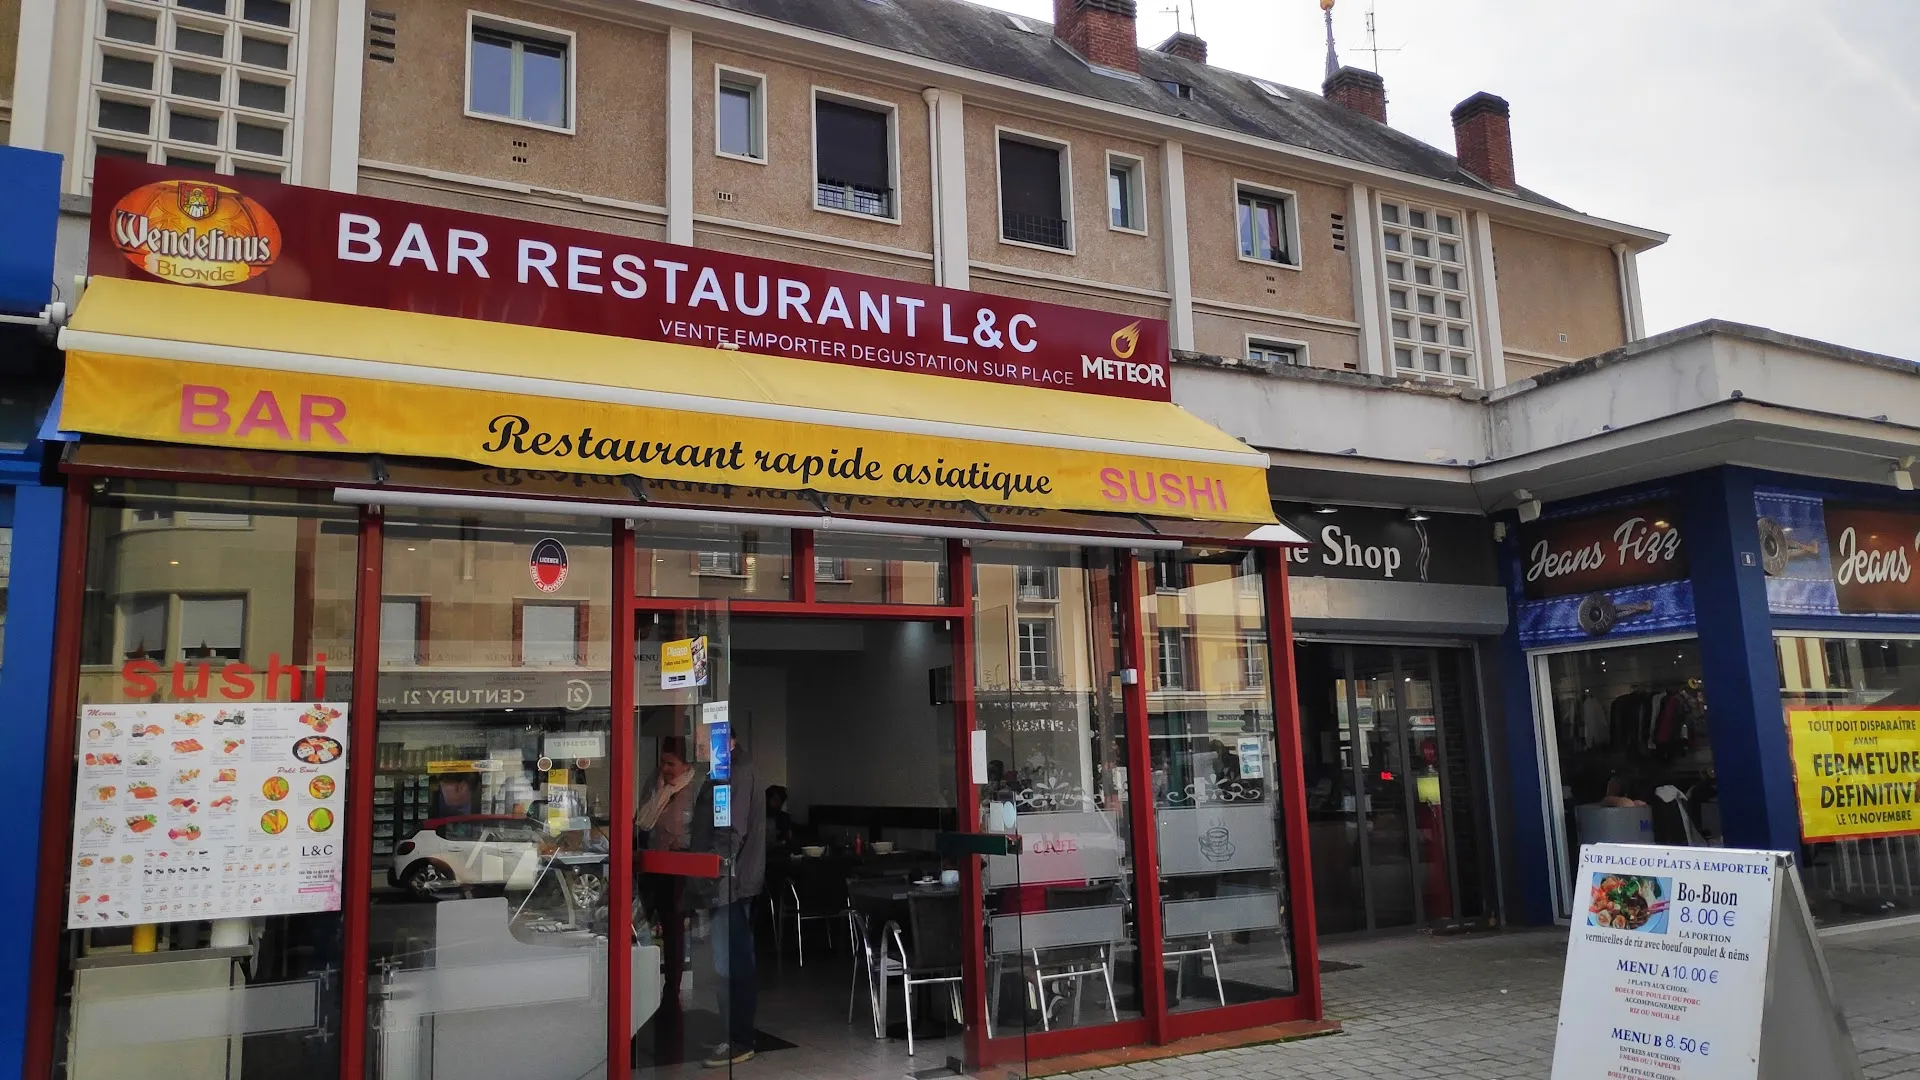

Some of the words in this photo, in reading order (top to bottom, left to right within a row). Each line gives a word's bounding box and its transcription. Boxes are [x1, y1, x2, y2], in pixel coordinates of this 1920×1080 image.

[115, 208, 270, 264] Wendelinus
[337, 212, 491, 279] BAR
[516, 239, 925, 339] RESTAURANT
[942, 302, 1038, 353] L&C
[659, 318, 730, 345] VENTE
[735, 328, 846, 358] EMPORTER
[851, 344, 979, 374] DEGUSTATION
[983, 361, 1016, 379] SUR
[1021, 365, 1075, 387] PLACE
[1081, 353, 1167, 388] METEOR
[178, 383, 349, 446] BAR
[482, 415, 745, 469] Restaurant
[754, 446, 884, 484] rapide
[892, 456, 1053, 500] asiatique
[1100, 467, 1226, 515] SUSHI
[1321, 524, 1401, 578] Shop
[1526, 531, 1606, 583] Jeans
[1613, 516, 1682, 567] Fizz
[1837, 526, 1911, 586] Jeans
[121, 652, 328, 700] sushi
[1808, 720, 1834, 732] TOUT
[1836, 720, 1858, 732] DOIT
[1860, 717, 1916, 731] DISPARAÎTRE
[1853, 736, 1879, 746] AVANT
[1812, 751, 1920, 777] FERMETURE
[1836, 814, 1847, 825] LE
[1848, 813, 1858, 825] 12
[1860, 809, 1912, 824] NOVEMBRE
[1584, 854, 1604, 864] SUR
[1605, 855, 1638, 867] PLACE
[1639, 857, 1656, 867] OU
[1657, 858, 1691, 870] PLATS
[1693, 858, 1701, 870] À
[1703, 861, 1769, 875] EMPORTER
[1677, 882, 1738, 906] Bo-Buon
[1585, 932, 1623, 946] vermicelles
[1624, 936, 1633, 947] de
[1634, 936, 1643, 948] riz
[1644, 940, 1660, 951] avec
[1661, 941, 1682, 954] boeuf
[1683, 946, 1692, 955] ou
[1693, 945, 1717, 959] poulet
[1718, 947, 1726, 959] &
[1678, 930, 1690, 939] LA
[1691, 932, 1731, 943] PORTION
[1616, 959, 1659, 976] MENU
[1661, 966, 1670, 978] A
[1631, 979, 1651, 988] PLATS
[1651, 981, 1666, 990] AUX
[1624, 996, 1687, 1012] ACCOMPAGNEMENT
[1646, 991, 1672, 1001] POULET
[1672, 995, 1682, 1003] OU
[1683, 997, 1701, 1006] PORC
[1611, 1027, 1651, 1045] MENU
[1653, 1035, 1662, 1046] B
[1619, 1046, 1646, 1056] ENTREES
[1646, 1051, 1659, 1059] AUX
[1622, 1054, 1639, 1063] NEMS
[1640, 1057, 1649, 1065] OU
[1653, 1060, 1681, 1071] VAPEURS
[1622, 1066, 1643, 1076] PLATS
[1642, 1069, 1655, 1078] AUX
